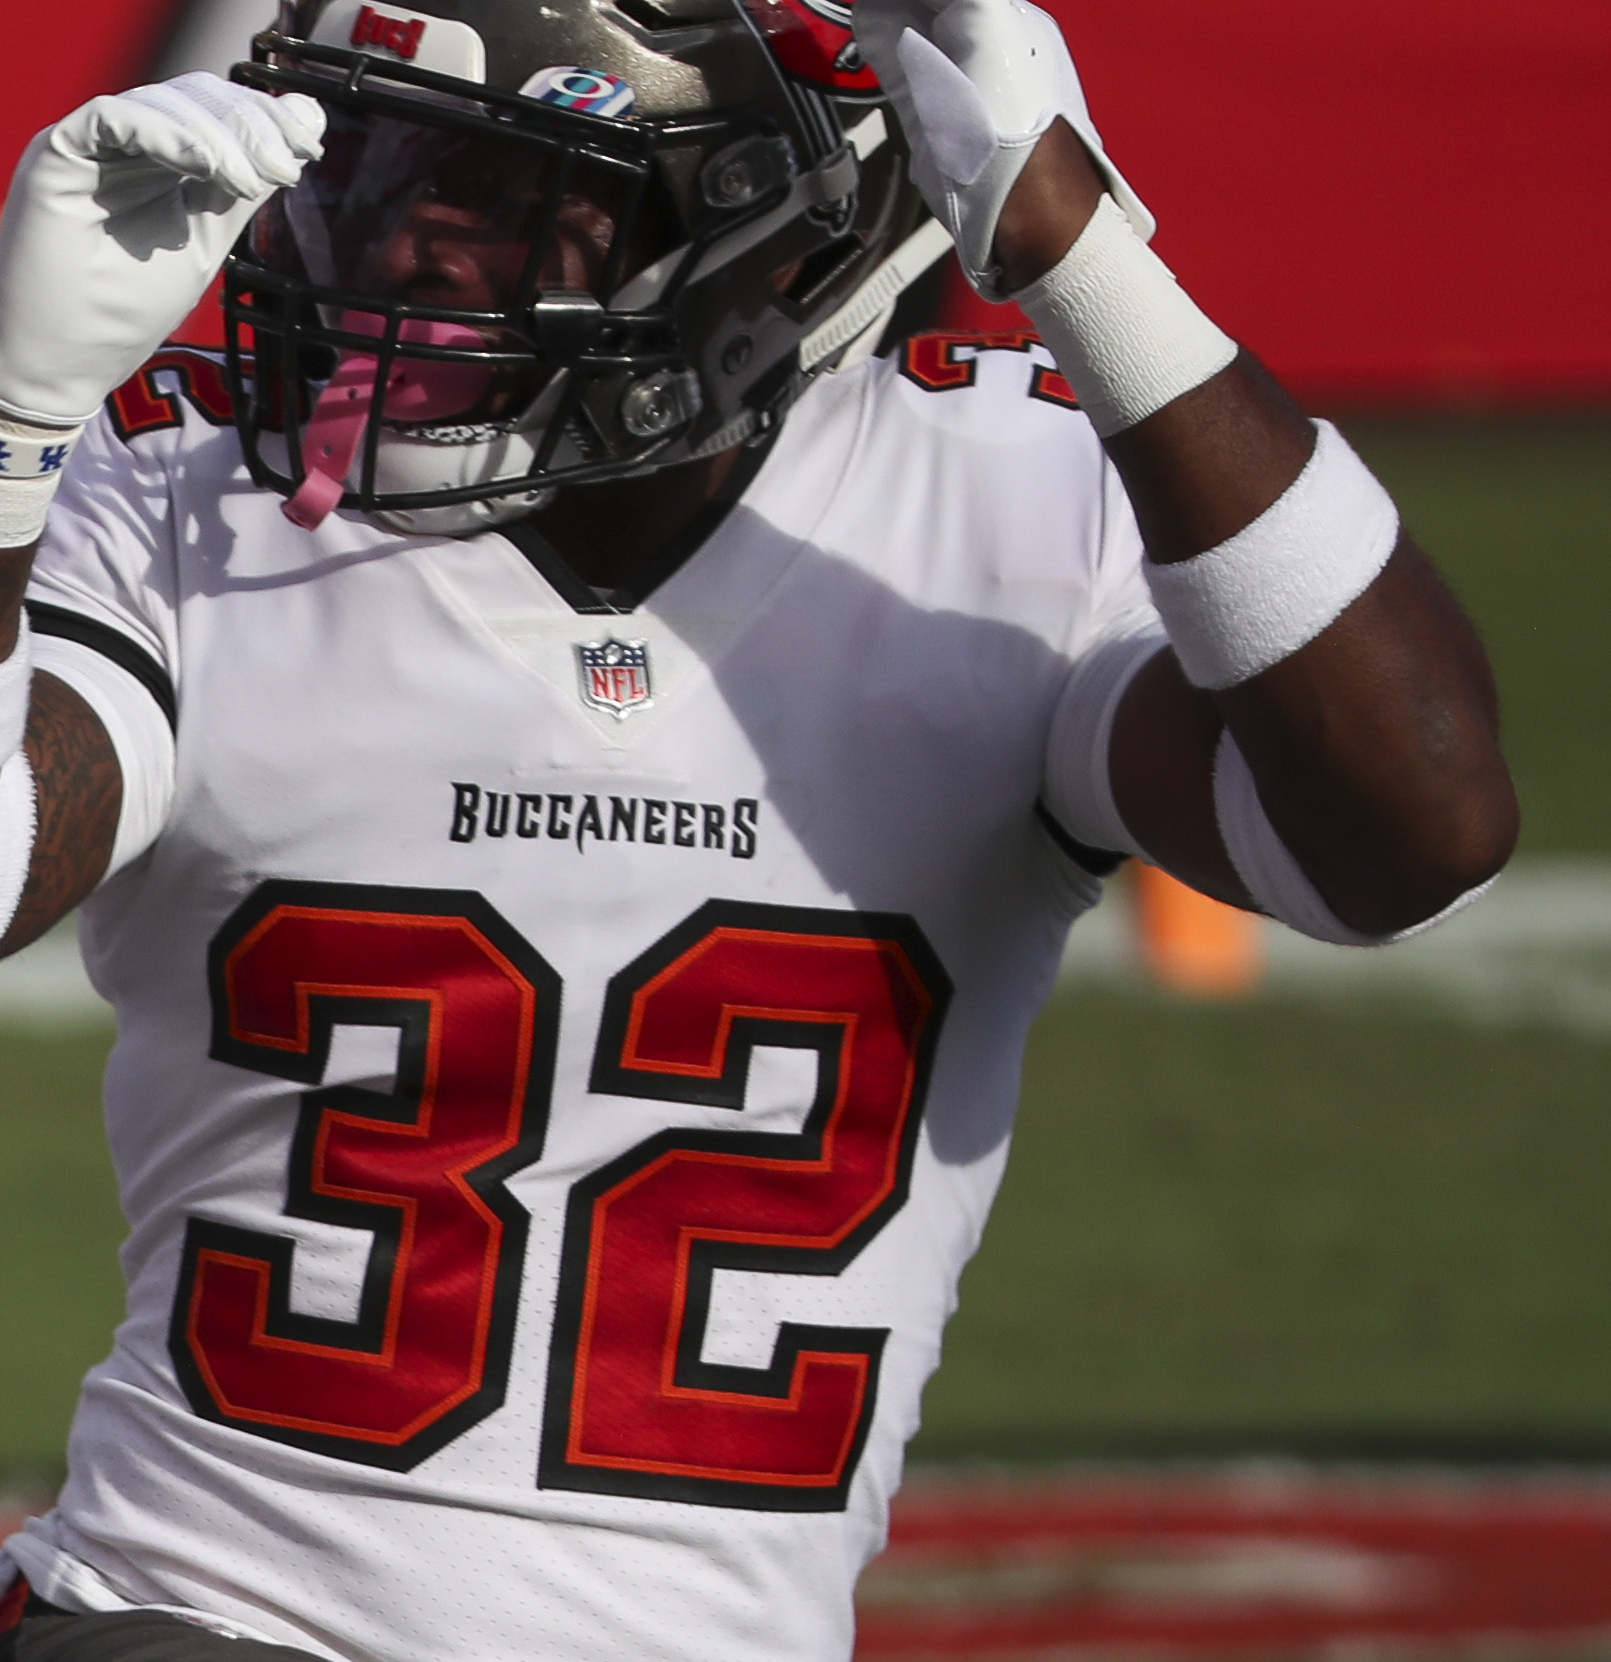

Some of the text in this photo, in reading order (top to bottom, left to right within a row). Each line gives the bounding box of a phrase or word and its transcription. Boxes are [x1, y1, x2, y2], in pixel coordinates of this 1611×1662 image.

[589, 667, 646, 702] NFL
[449, 781, 759, 859] BUCCANEERS
[168, 877, 956, 1513] 32
